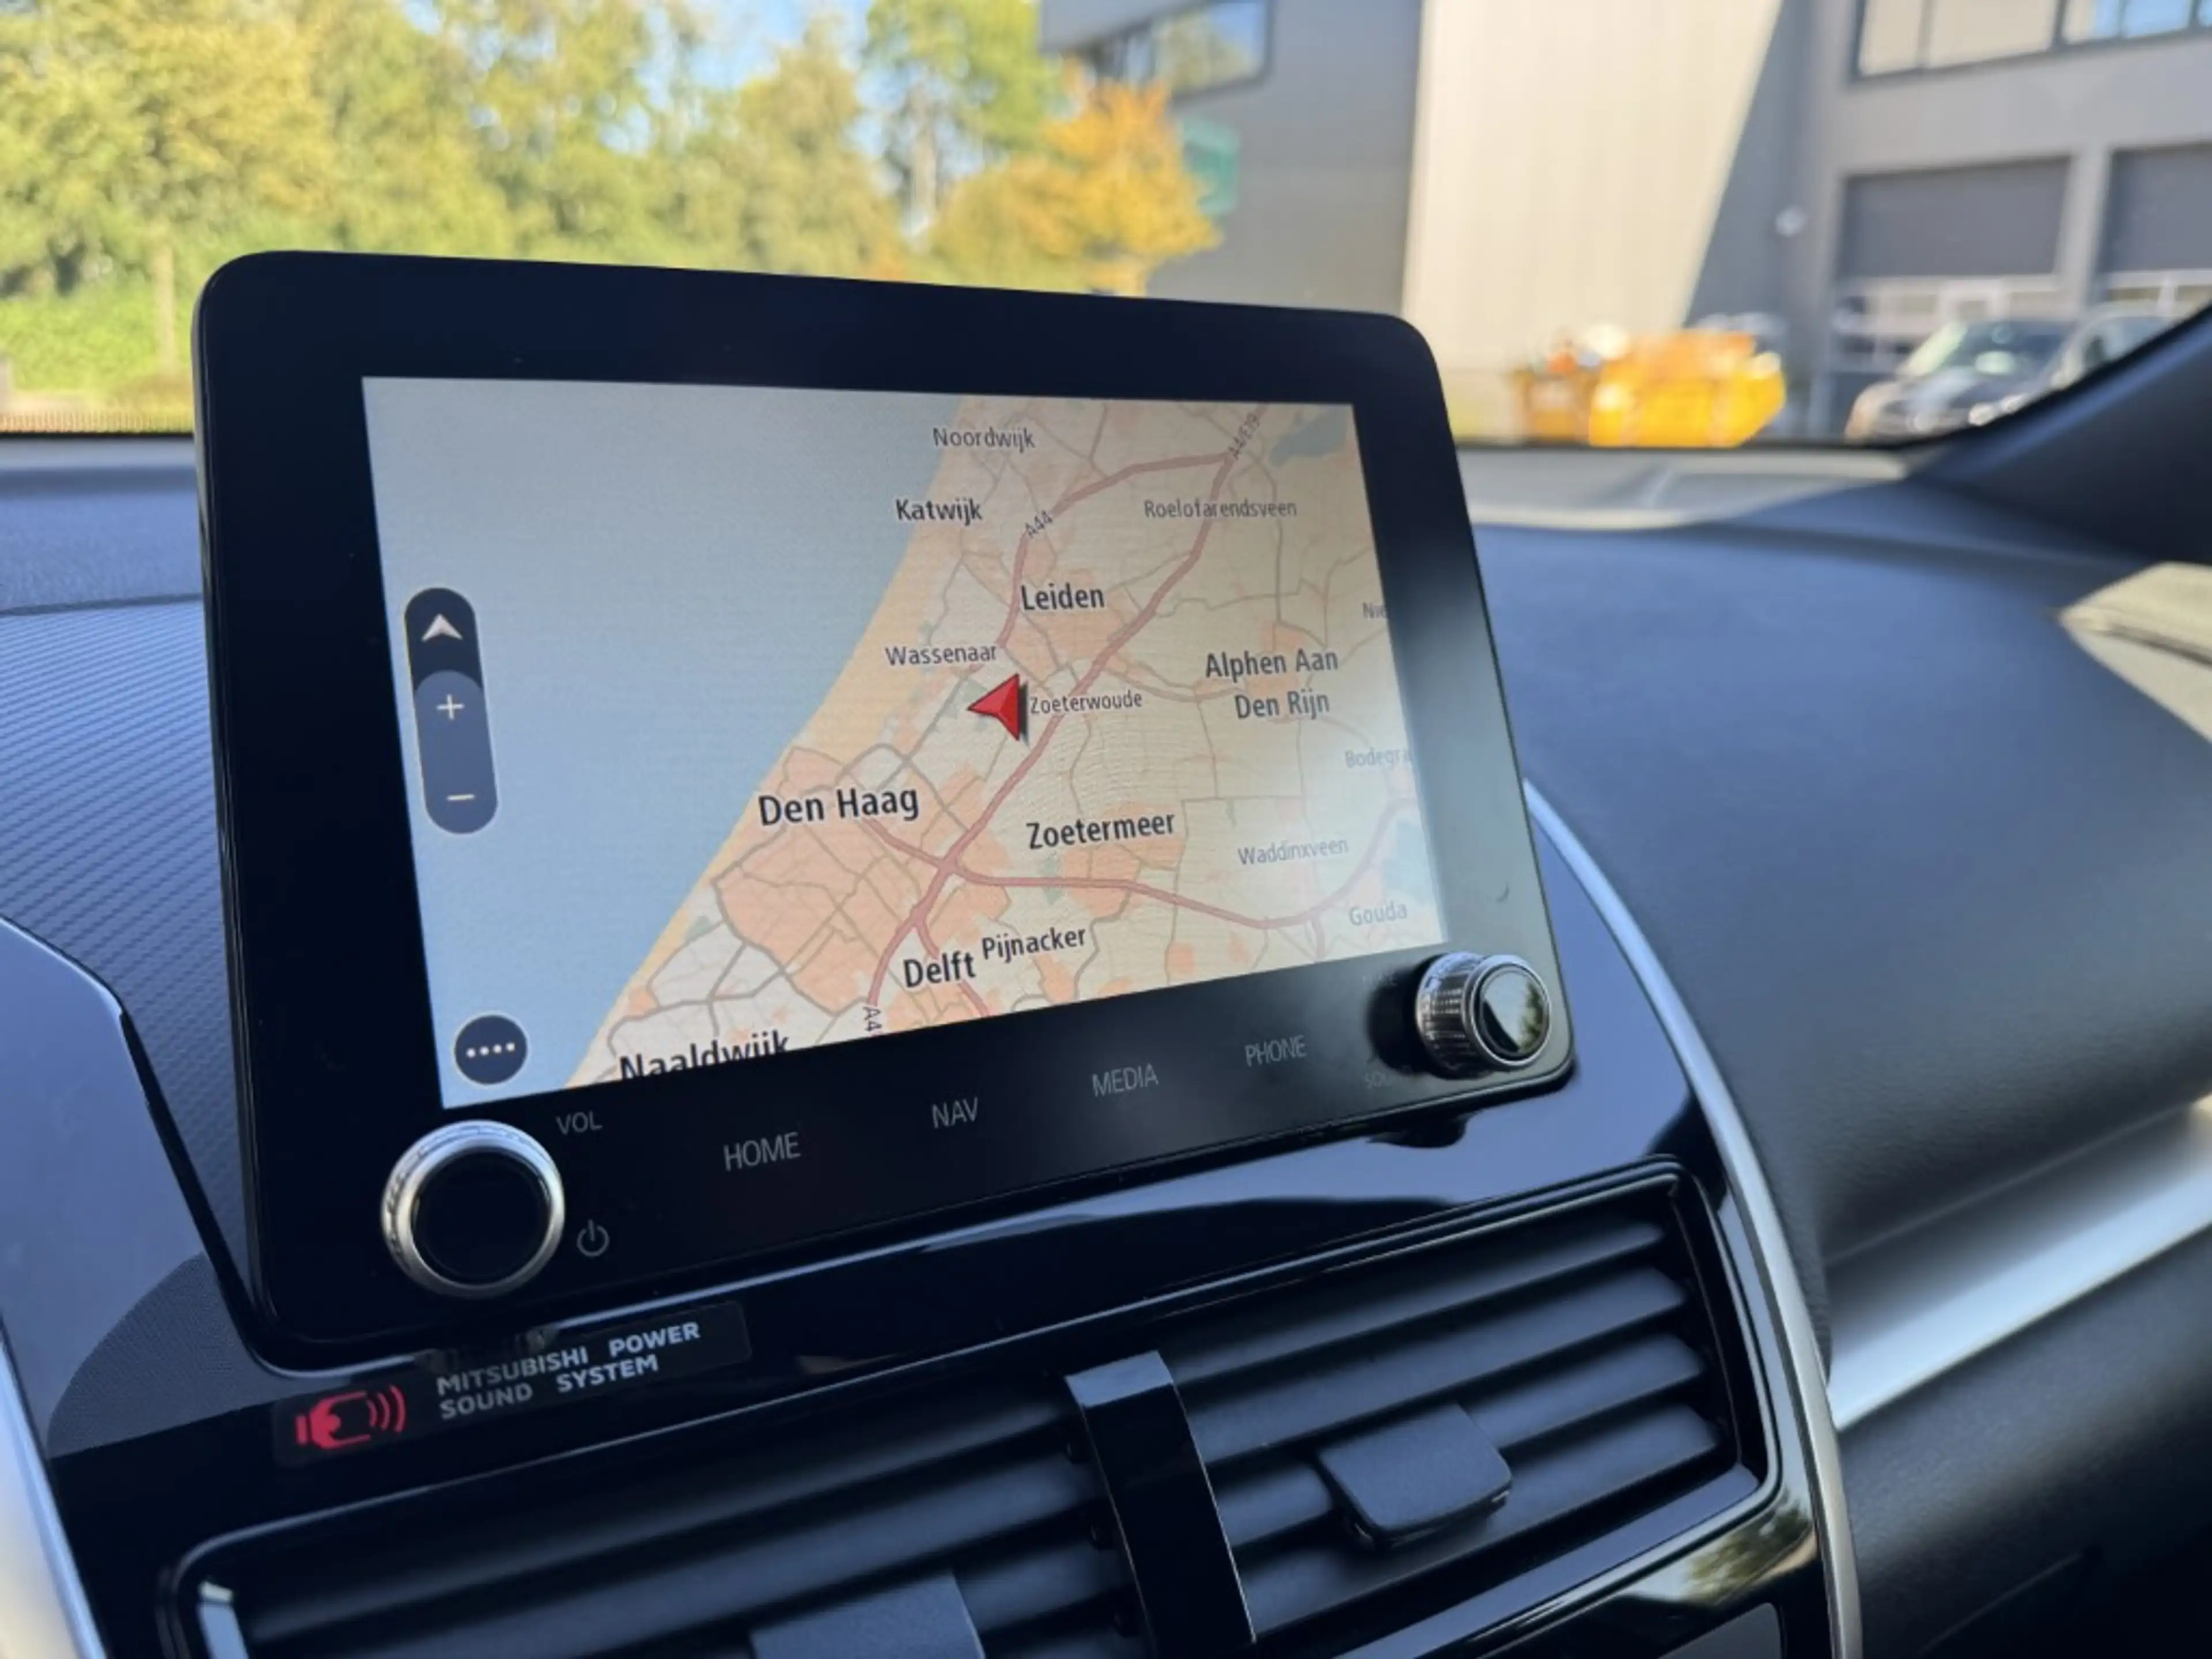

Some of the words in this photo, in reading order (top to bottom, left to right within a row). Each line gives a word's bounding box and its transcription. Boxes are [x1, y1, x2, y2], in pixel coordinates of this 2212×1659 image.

[933, 426, 1036, 450] Noordwijk
[895, 498, 983, 525] Katwijk
[1144, 497, 1297, 519] Roelofarendsveen
[1026, 509, 1054, 539] A44
[1021, 583, 1105, 611] Leiden
[885, 644, 998, 666] Wassenaar
[1205, 650, 1287, 683] Alphen
[1296, 648, 1339, 672] Aan
[1029, 690, 1143, 715] Zoeterwoude
[1235, 693, 1280, 719] Den
[1287, 689, 1330, 720] Rijn
[757, 793, 825, 826] Den
[836, 786, 919, 822] Haag
[1027, 811, 1176, 850] Zoetermeer
[1238, 838, 1349, 866] Waddinxveen
[1349, 900, 1408, 927] Gouda
[981, 925, 1087, 964] Pijnacker
[903, 951, 976, 987] Delft
[619, 1029, 789, 1080] Naaldwijk
[1244, 1036, 1308, 1067] PHONE
[1091, 1063, 1160, 1099] MEDIA
[556, 1111, 603, 1135] VOL
[931, 1097, 980, 1130] NAV
[724, 1132, 802, 1172] HOME
[435, 1346, 588, 1397] MITSUBISHI
[608, 1321, 700, 1357] POWER
[440, 1383, 533, 1420] SOUND
[555, 1354, 658, 1393] SYSTEM
